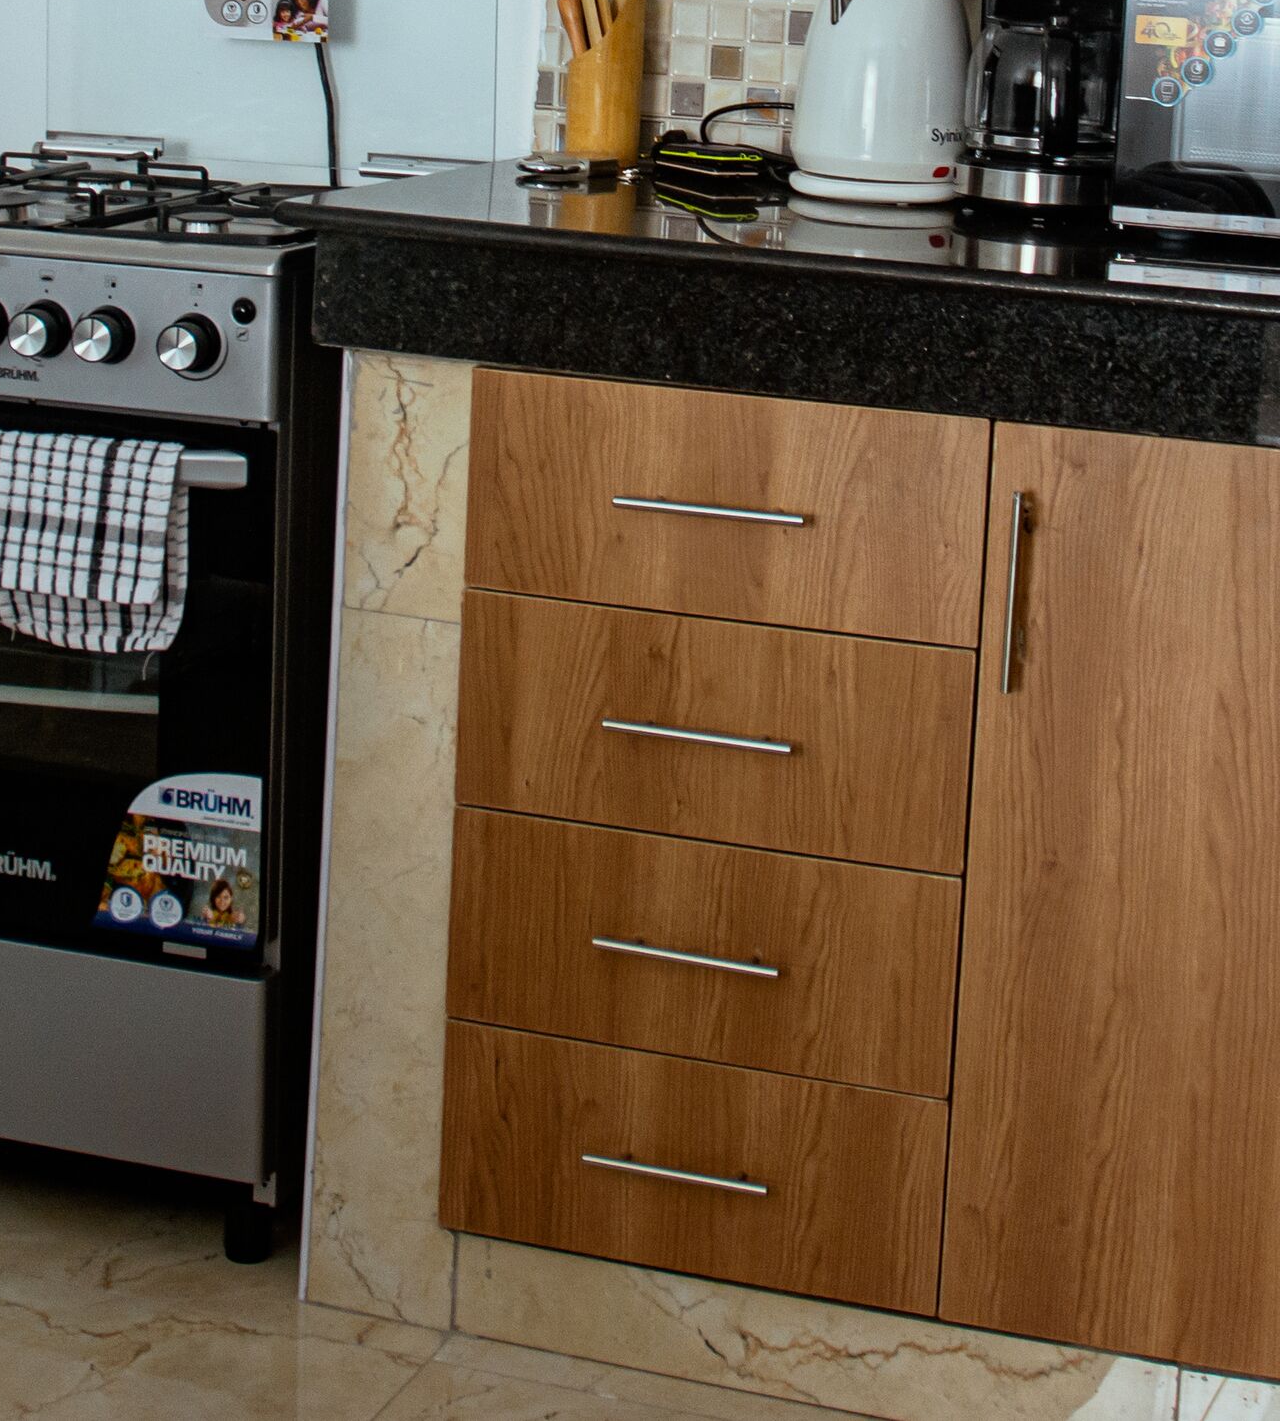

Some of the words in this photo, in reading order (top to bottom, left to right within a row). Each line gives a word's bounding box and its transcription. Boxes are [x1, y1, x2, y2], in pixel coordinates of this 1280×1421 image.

[176, 788, 251, 818] BRÜHM
[142, 834, 247, 867] PREMIUM
[141, 854, 227, 882] QUALITY
